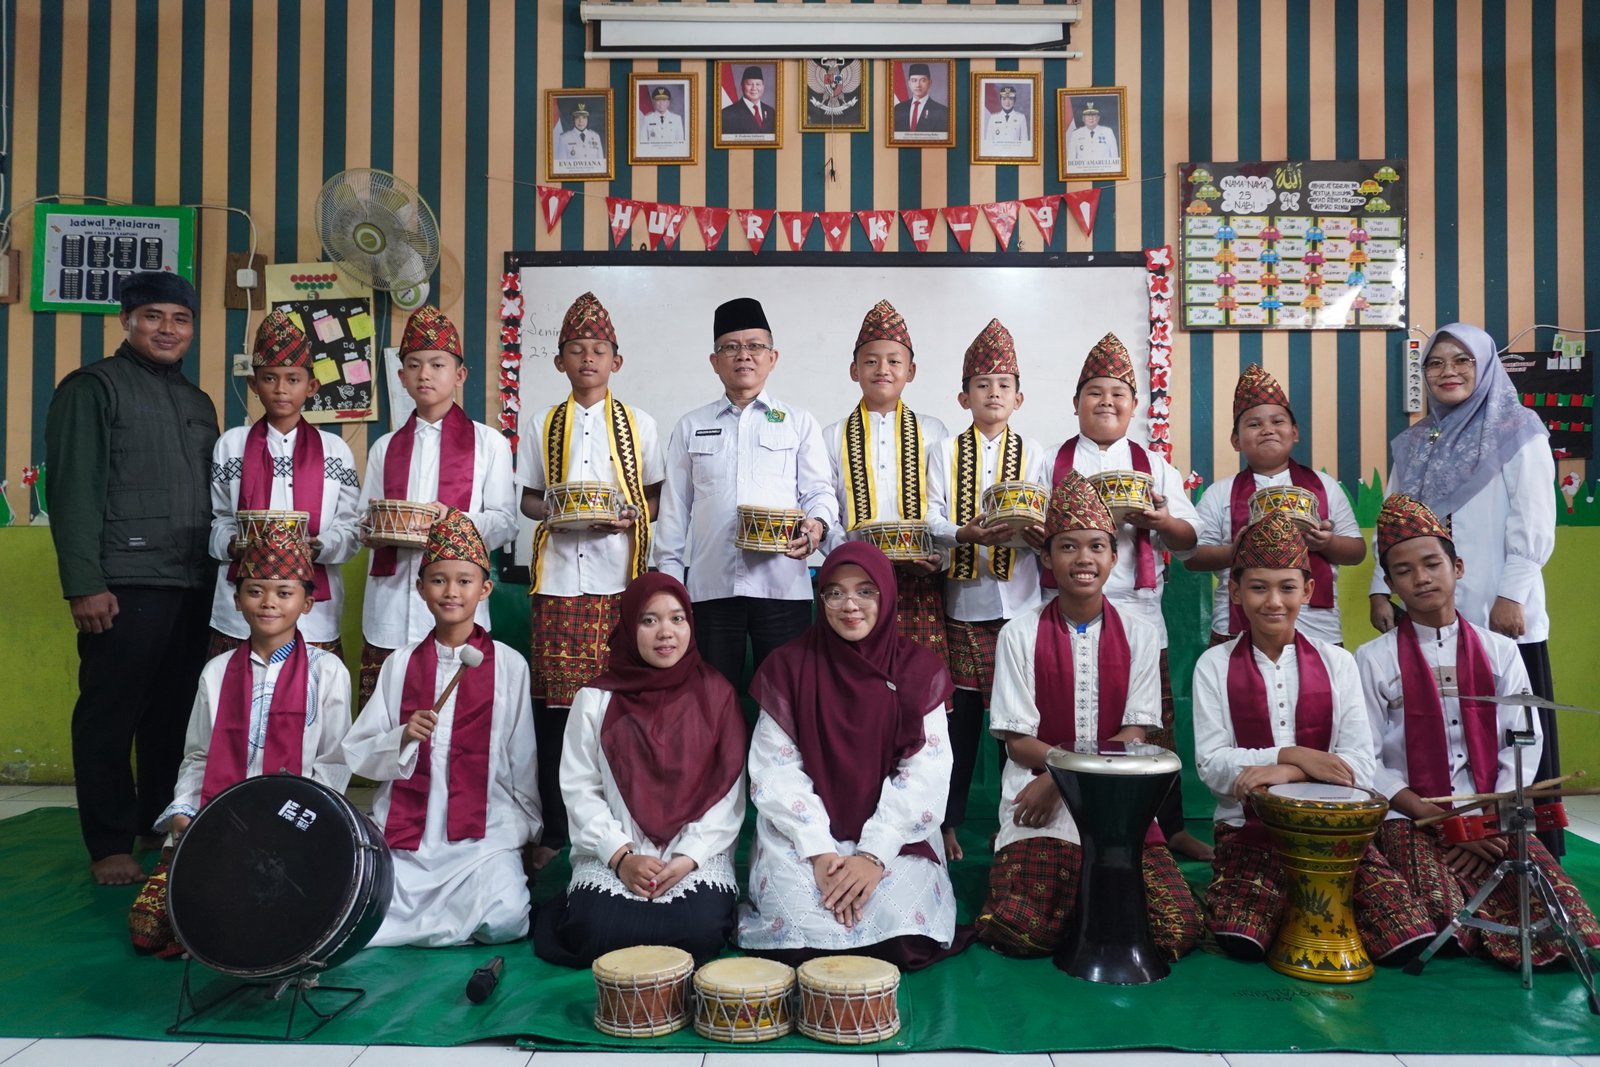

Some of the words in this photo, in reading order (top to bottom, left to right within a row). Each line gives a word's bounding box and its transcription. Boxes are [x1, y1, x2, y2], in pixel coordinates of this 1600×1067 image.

[1224, 179, 1245, 188] NAMA
[1247, 180, 1268, 190] NAMA
[1238, 191, 1252, 200] 25
[1234, 201, 1256, 210] NABI
[70, 218, 105, 228] Jadwal
[109, 218, 161, 230] Pelajaran
